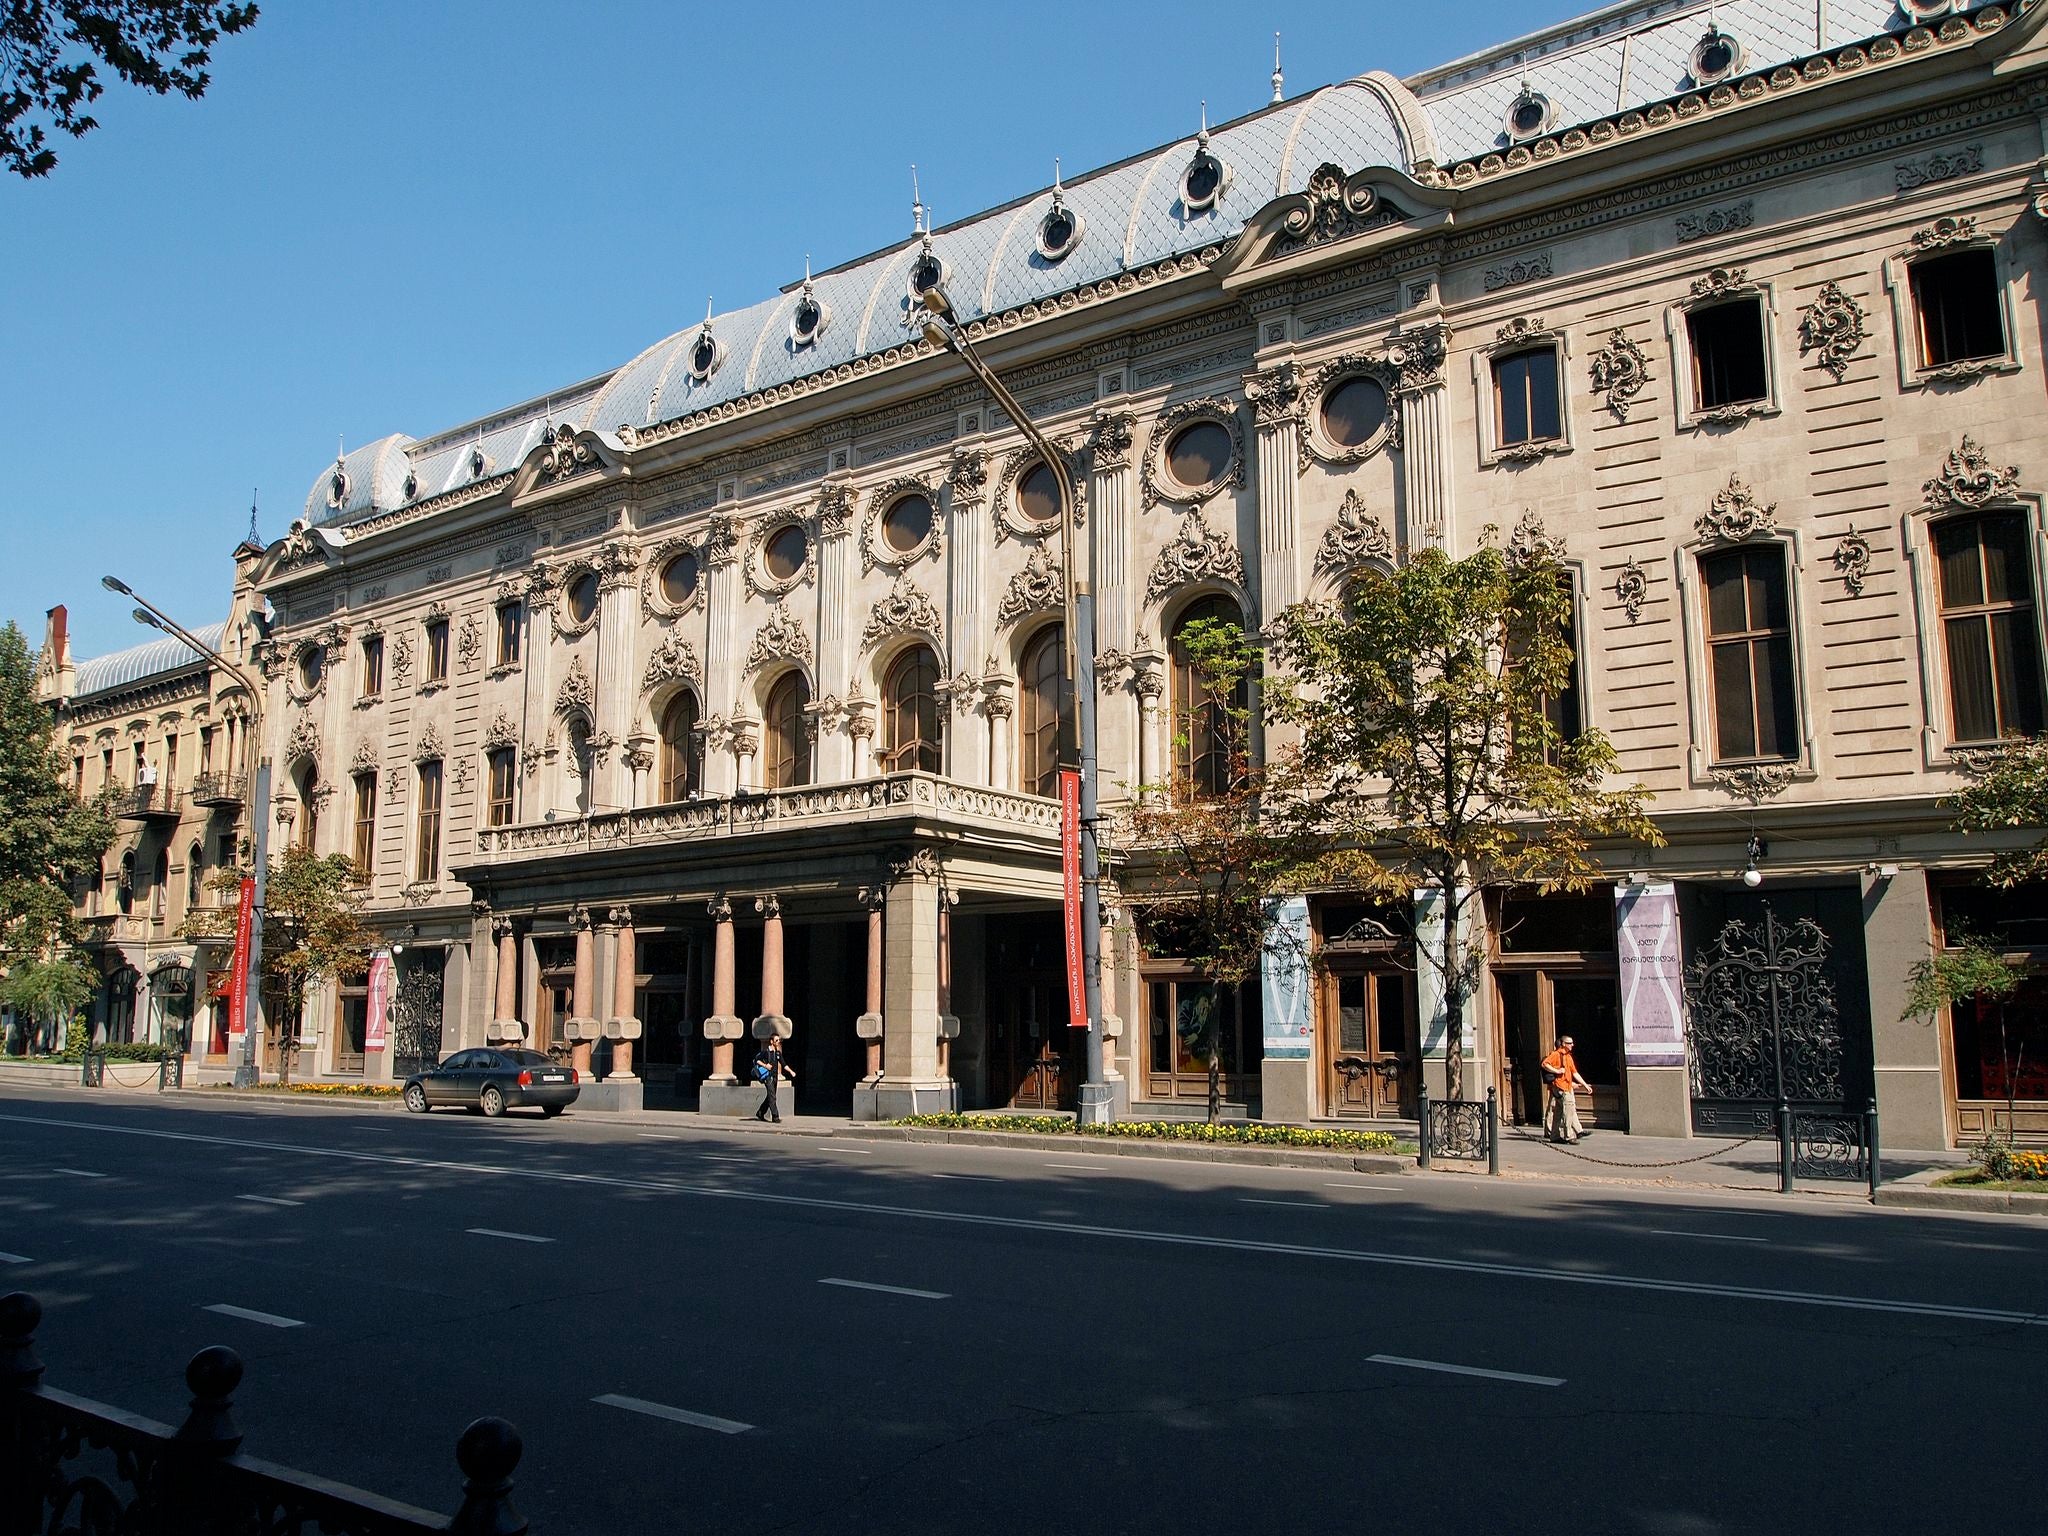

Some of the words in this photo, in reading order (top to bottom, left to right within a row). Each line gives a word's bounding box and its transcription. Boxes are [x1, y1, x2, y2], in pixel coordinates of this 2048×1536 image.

[242, 887, 250, 914] THEATRE
[238, 925, 246, 953] FESTIVAL
[234, 954, 243, 1006] INTERNATIONAL
